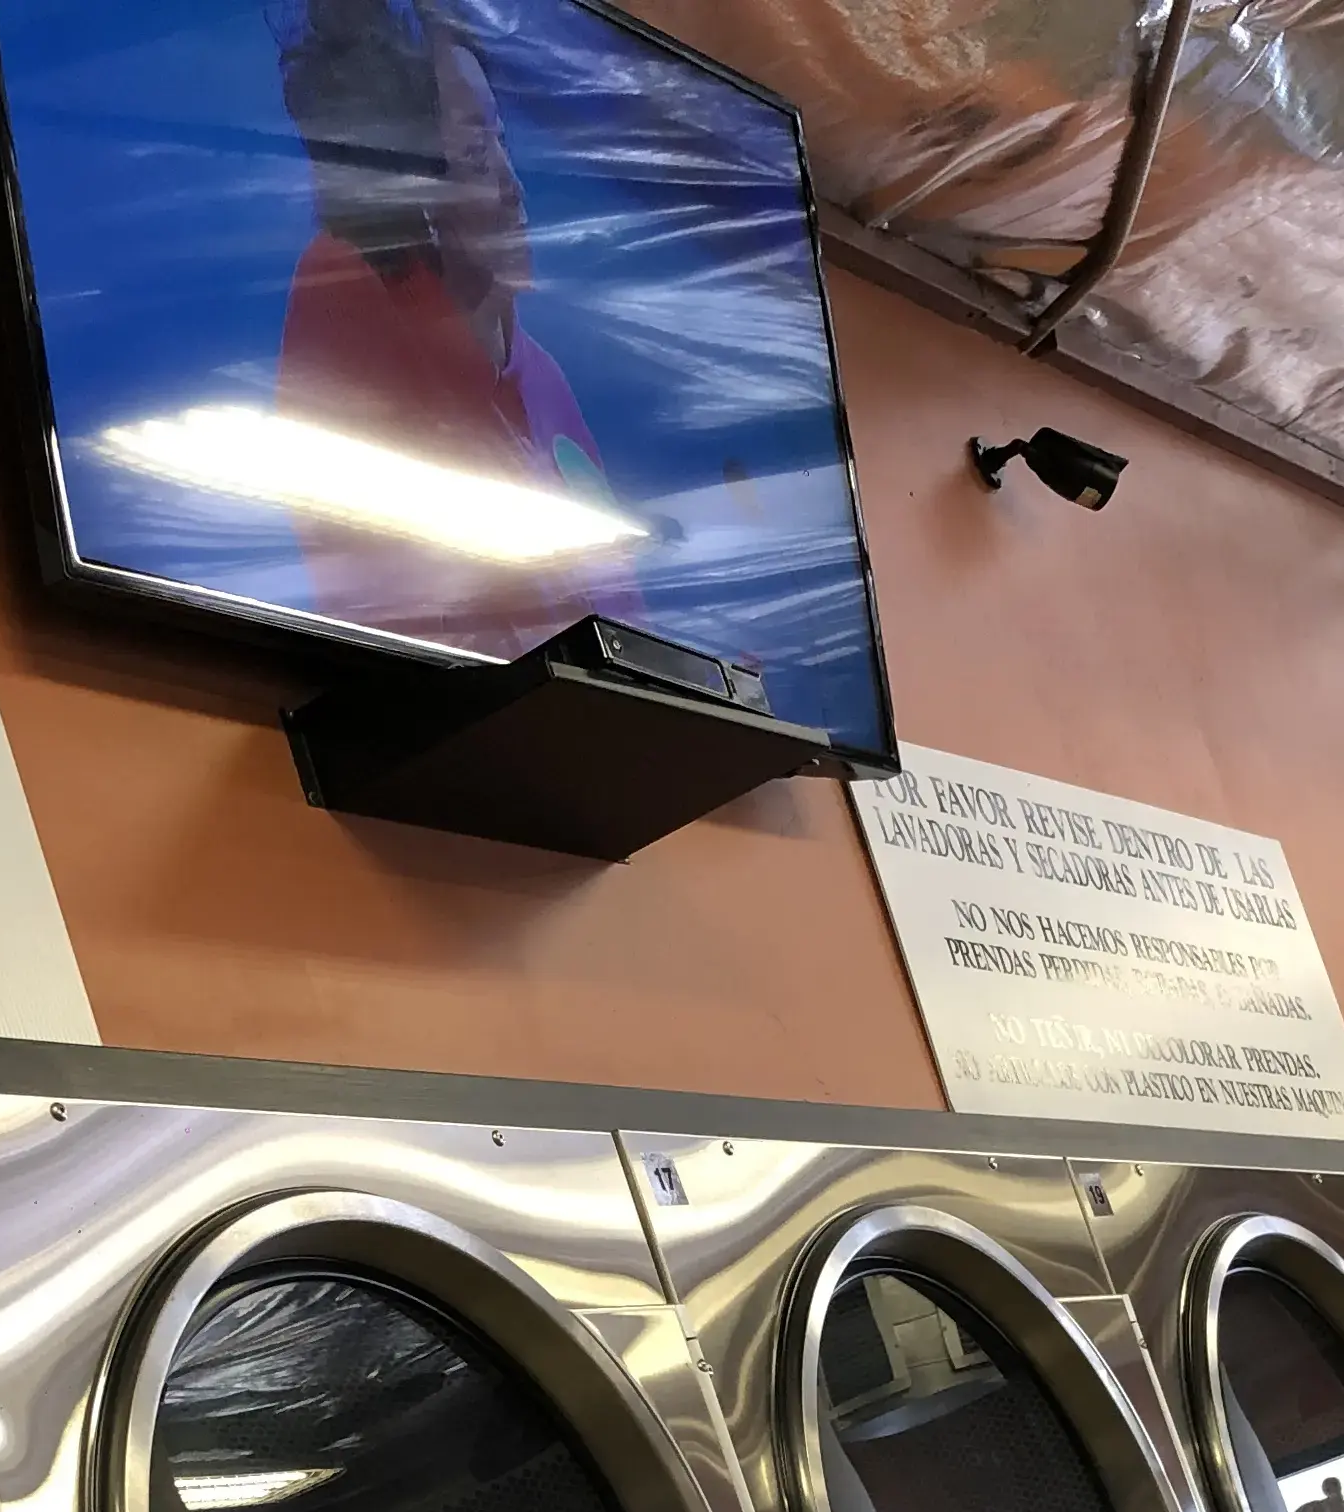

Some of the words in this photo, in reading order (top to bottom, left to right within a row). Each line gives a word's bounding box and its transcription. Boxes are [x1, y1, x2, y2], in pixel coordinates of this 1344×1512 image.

[929, 776, 1016, 829] FAVOR
[1017, 798, 1102, 850] REVISE
[1102, 820, 1193, 871] DENTRO
[1195, 843, 1228, 879] DE
[1234, 852, 1274, 889] LAS
[873, 806, 1004, 869] LAVADORAS
[1003, 837, 1024, 873] Y
[1026, 842, 1137, 898] SECADORAS
[1141, 868, 1198, 911] ANTES
[1196, 881, 1224, 915] DE
[1222, 887, 1297, 930] USARLAS
[951, 899, 987, 932] NO
[990, 907, 1035, 940] NOS
[1036, 916, 1129, 957] HACEMOS
[944, 937, 1037, 978] PRENDAS
[988, 1012, 1025, 1045] NO
[1133, 1032, 1242, 1070] DECOLORAR
[1241, 1046, 1320, 1079] PRENDAS.
[1121, 1069, 1194, 1102] PLASTICO
[1196, 1077, 1219, 1103] EN
[1219, 1079, 1293, 1111] NUESTRAS
[654, 1167, 674, 1192] 17
[1089, 1185, 1105, 1204] 19
